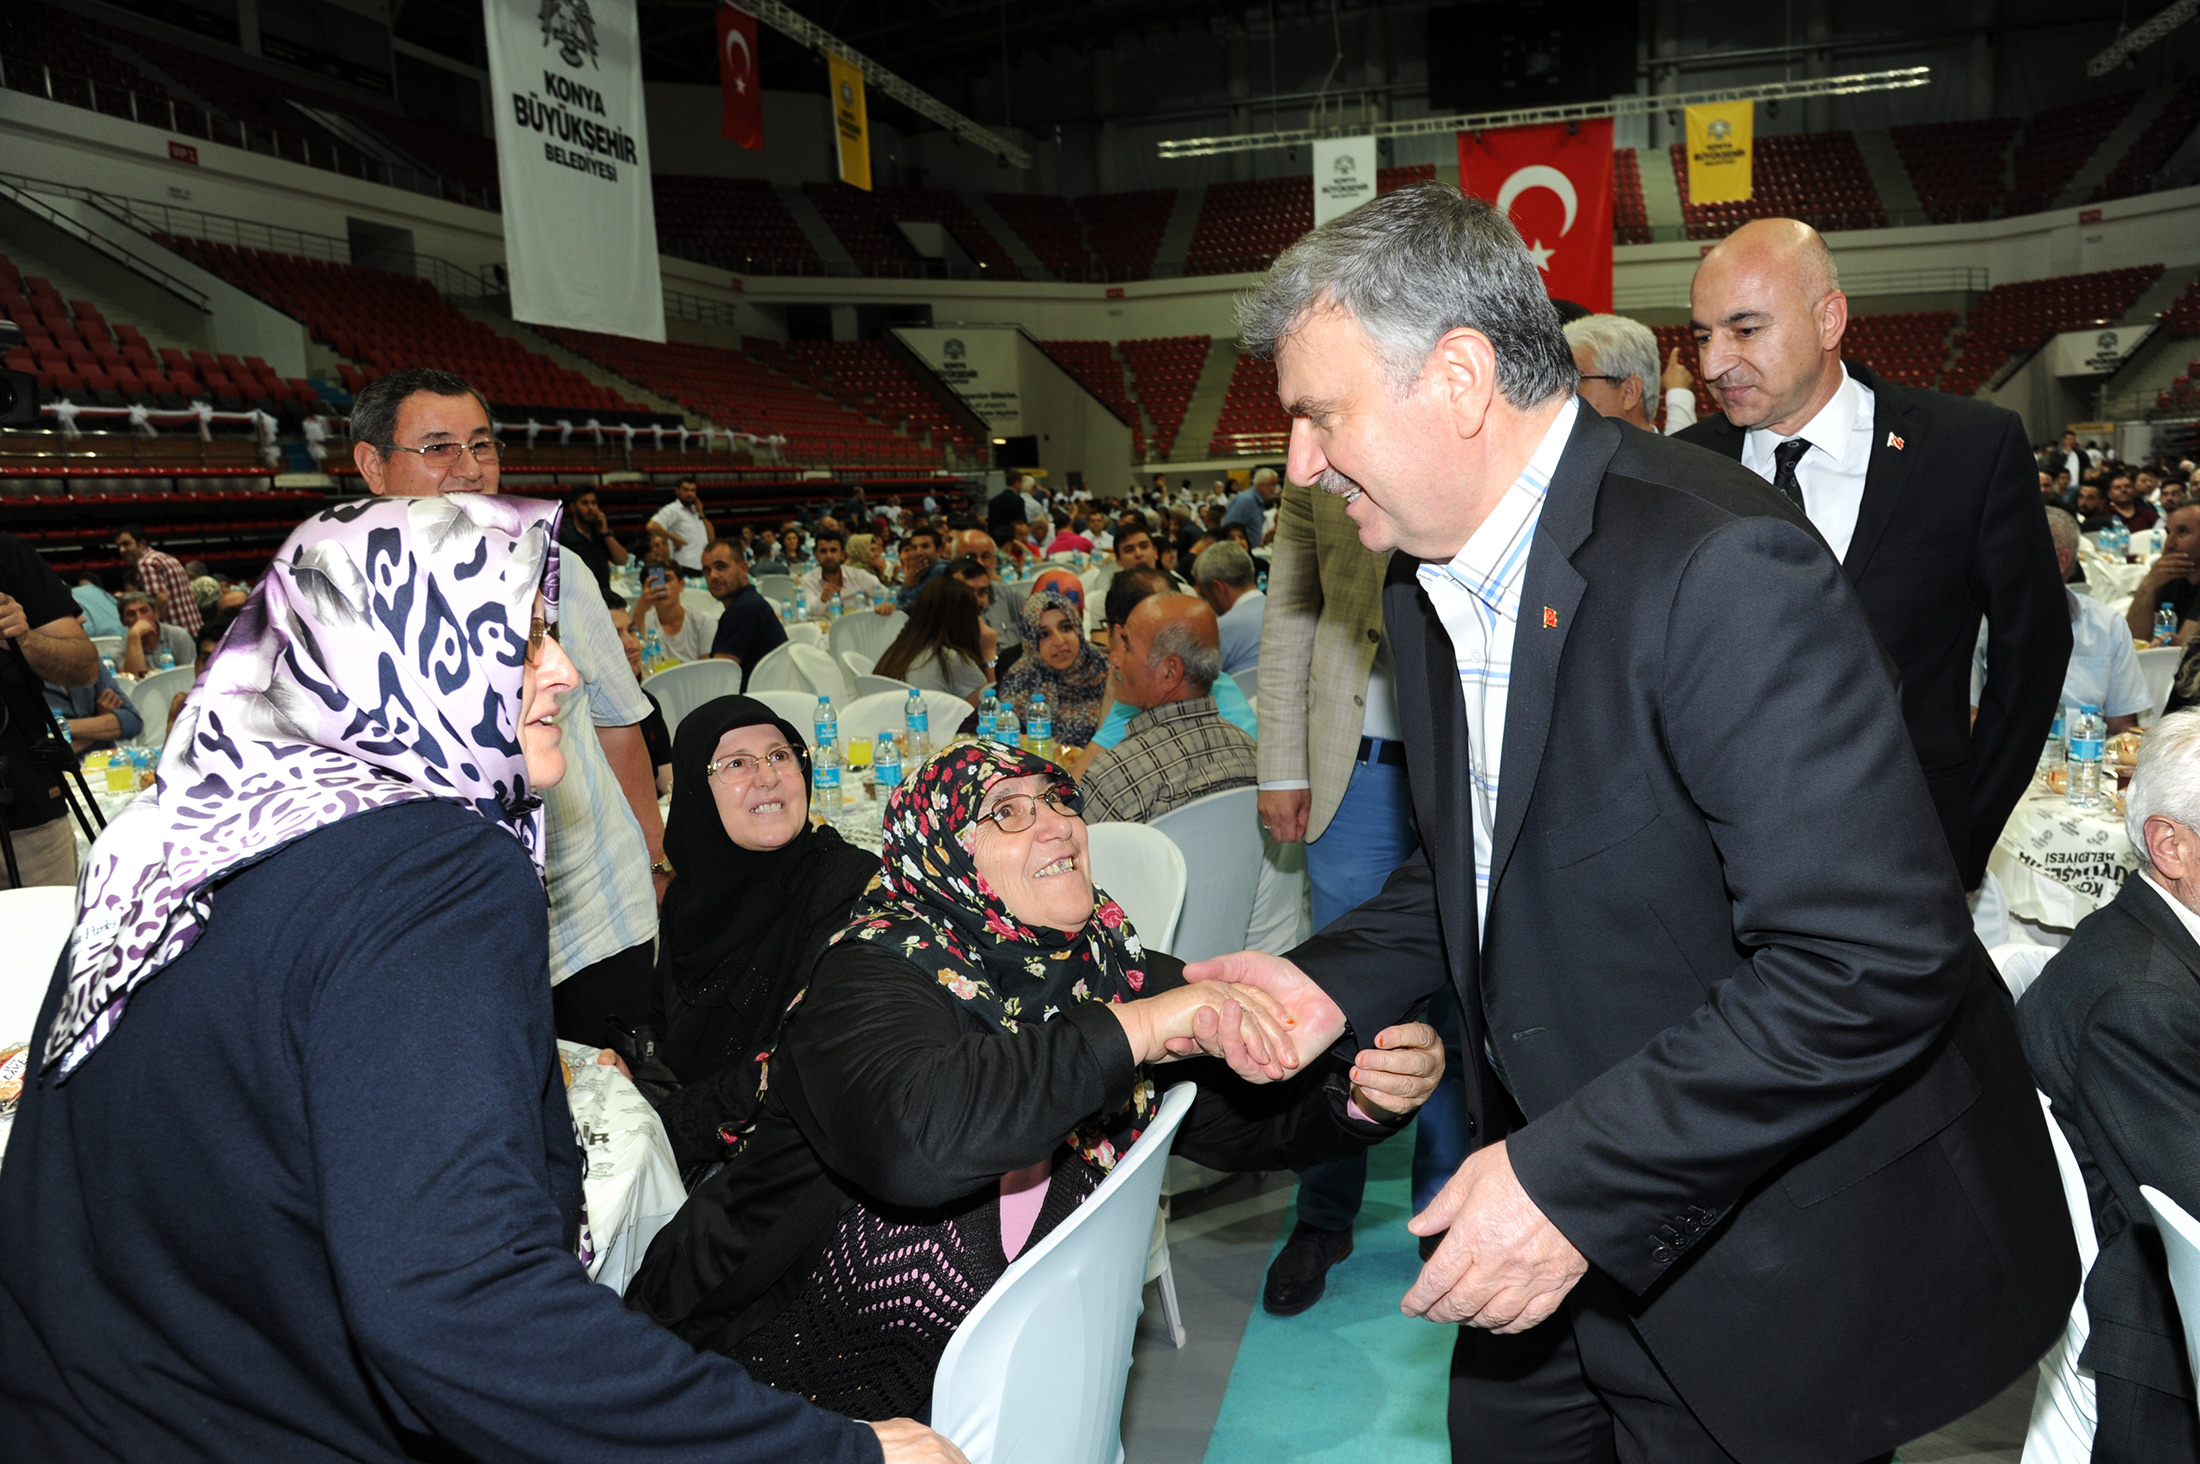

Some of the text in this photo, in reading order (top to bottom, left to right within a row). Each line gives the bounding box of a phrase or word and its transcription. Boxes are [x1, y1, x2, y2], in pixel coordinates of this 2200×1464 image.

[543, 70, 606, 118] KONYA
[512, 91, 638, 166] BÜYÜKŞEHİR
[544, 142, 618, 183] BELEDİYESİ
